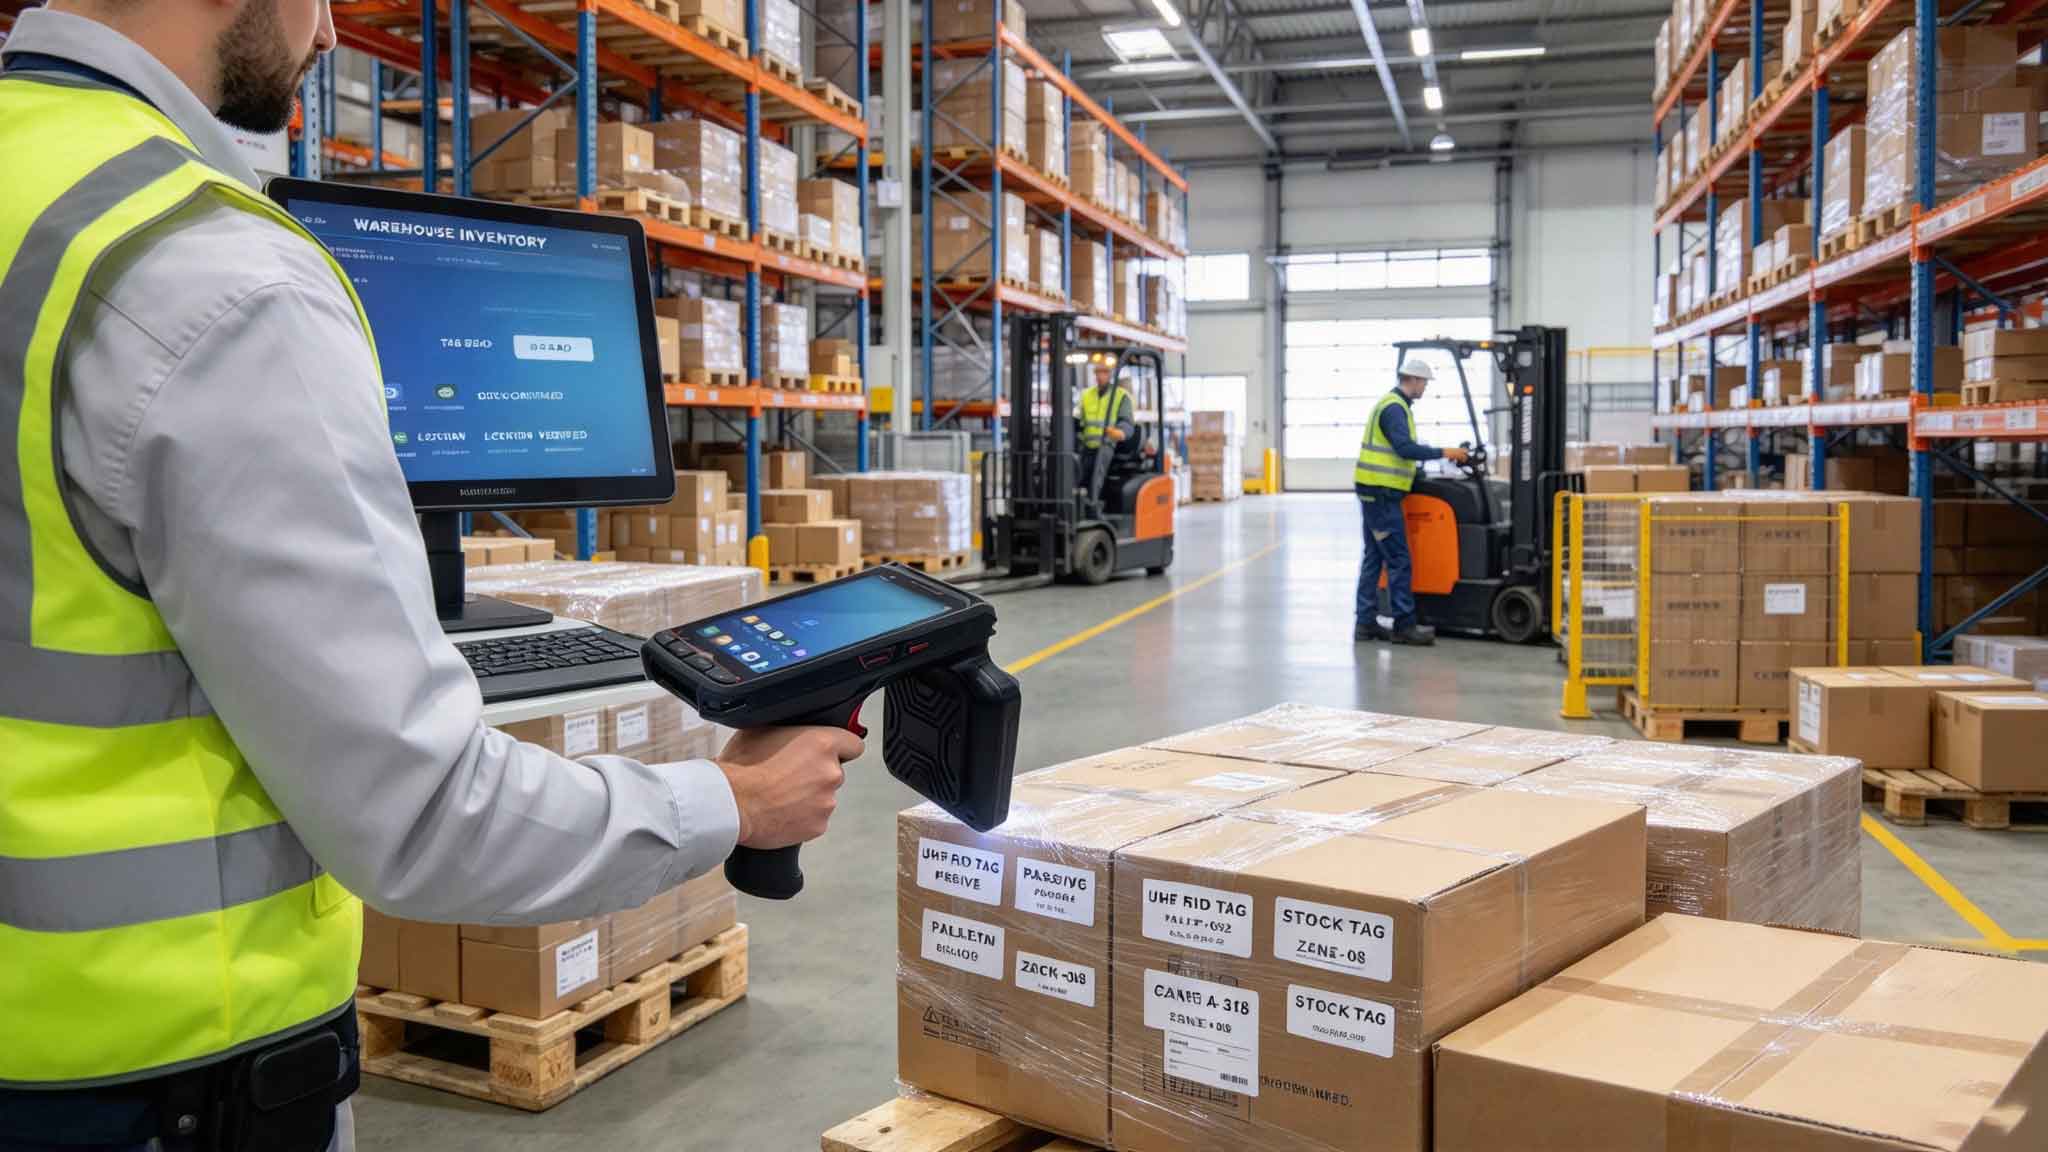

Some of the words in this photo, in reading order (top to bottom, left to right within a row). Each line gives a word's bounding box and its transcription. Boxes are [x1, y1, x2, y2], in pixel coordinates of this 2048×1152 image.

[353, 218, 455, 239] WAREHOUSE
[460, 229, 547, 249] INVENTORY
[976, 858, 1000, 874] TAG
[1216, 900, 1247, 917] TAG
[1282, 909, 1343, 932] STOCK
[1349, 919, 1385, 939] TAG
[1295, 994, 1350, 1019] STOCK
[1354, 1007, 1386, 1026] TAG
